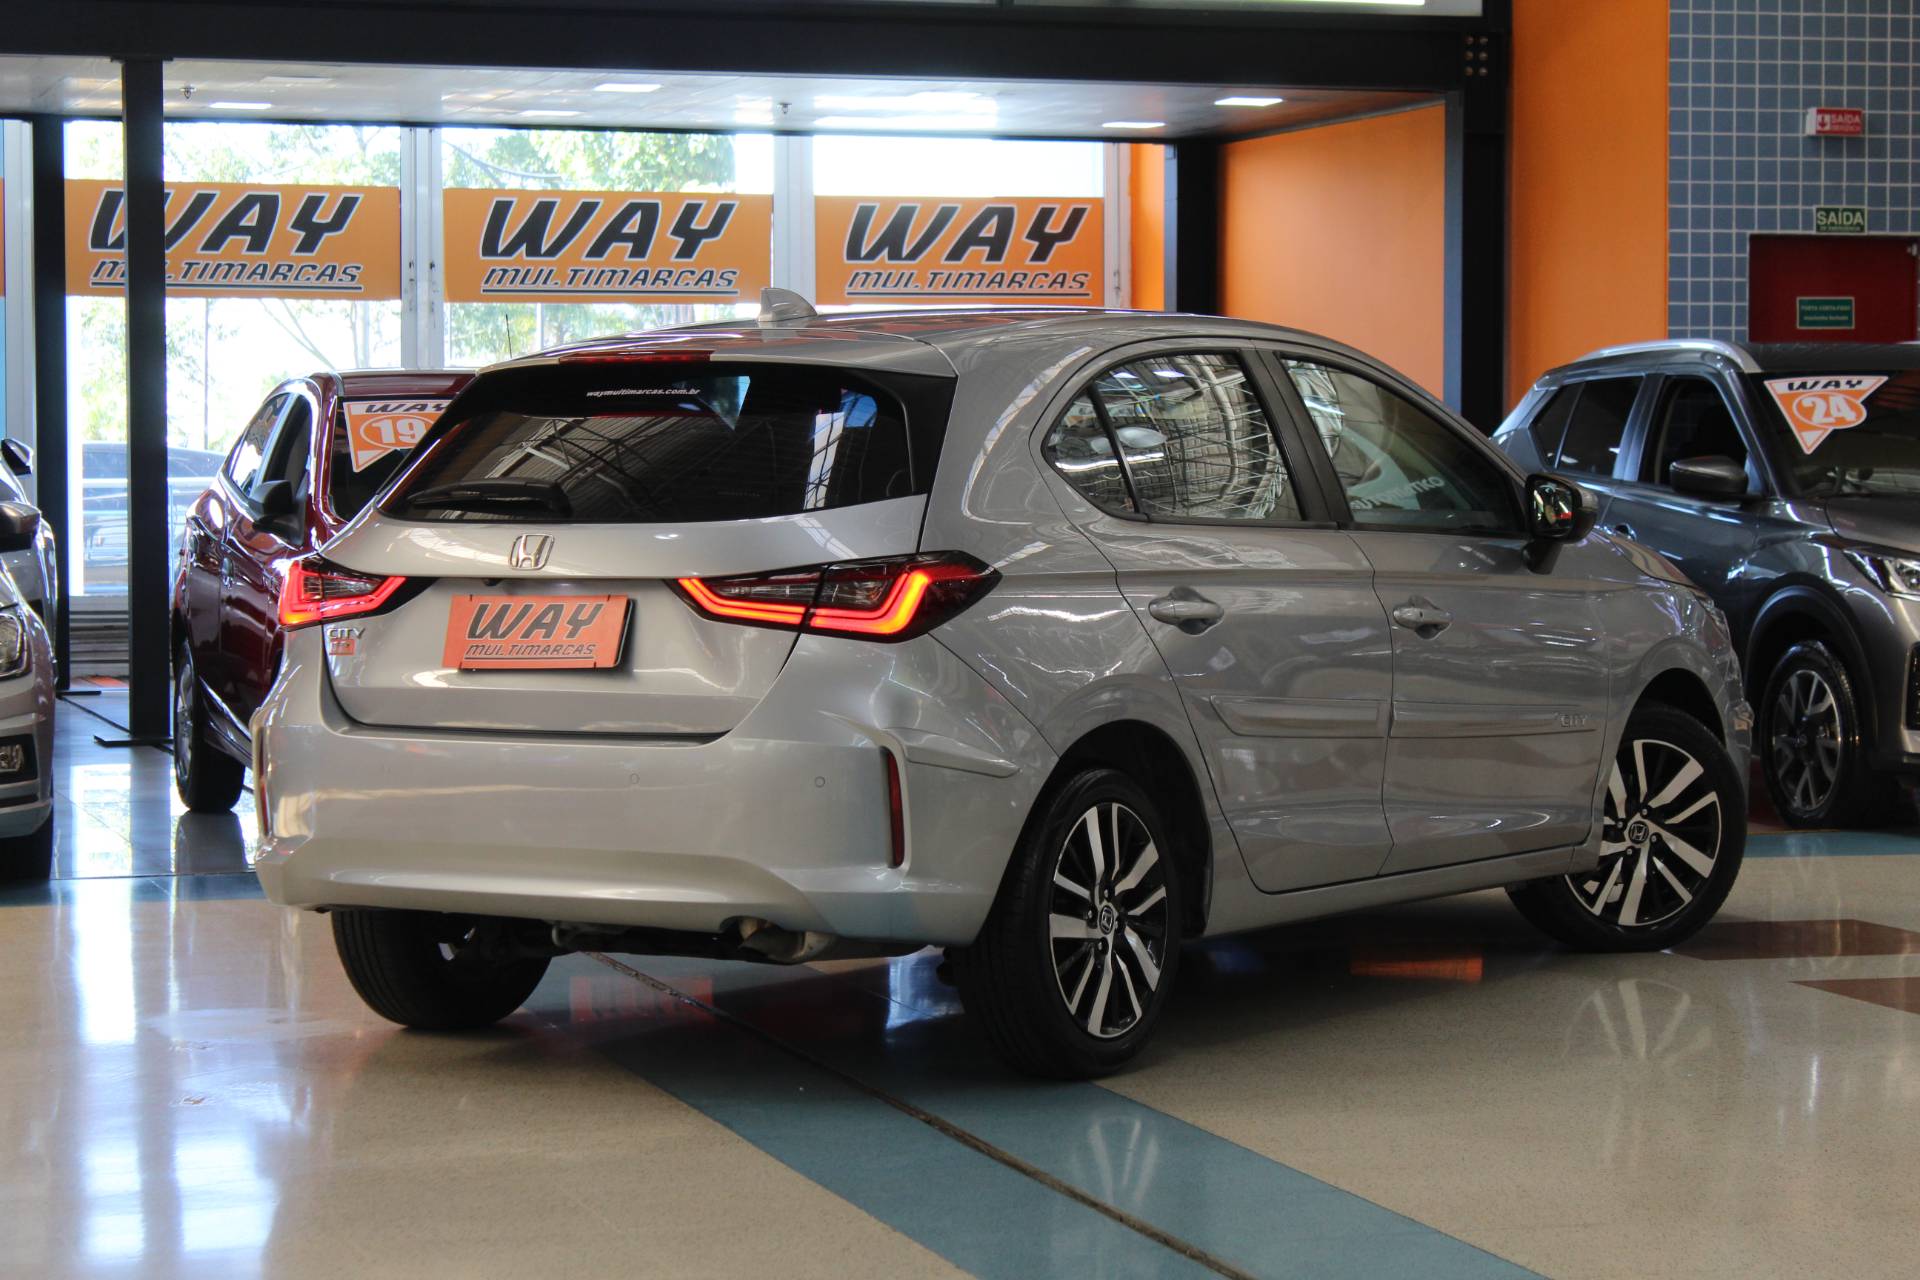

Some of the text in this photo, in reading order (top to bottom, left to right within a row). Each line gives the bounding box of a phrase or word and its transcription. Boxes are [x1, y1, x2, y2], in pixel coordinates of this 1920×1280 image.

[1816, 208, 1864, 226] SAÍDA
[480, 197, 738, 261] WAY
[844, 203, 1091, 264] WAY
[91, 259, 363, 283] MTIMARCAS
[482, 266, 739, 289] MULTIMARCAS
[847, 270, 1091, 290] MULTIMARCAS
[586, 388, 700, 397] waymultimarcas.com.br
[1787, 380, 1862, 391] WAY
[1801, 396, 1857, 423] 24
[371, 418, 427, 443] 19
[326, 627, 366, 639] CITY
[464, 602, 605, 641] WAY
[465, 643, 597, 656] MULTIMARCAS
